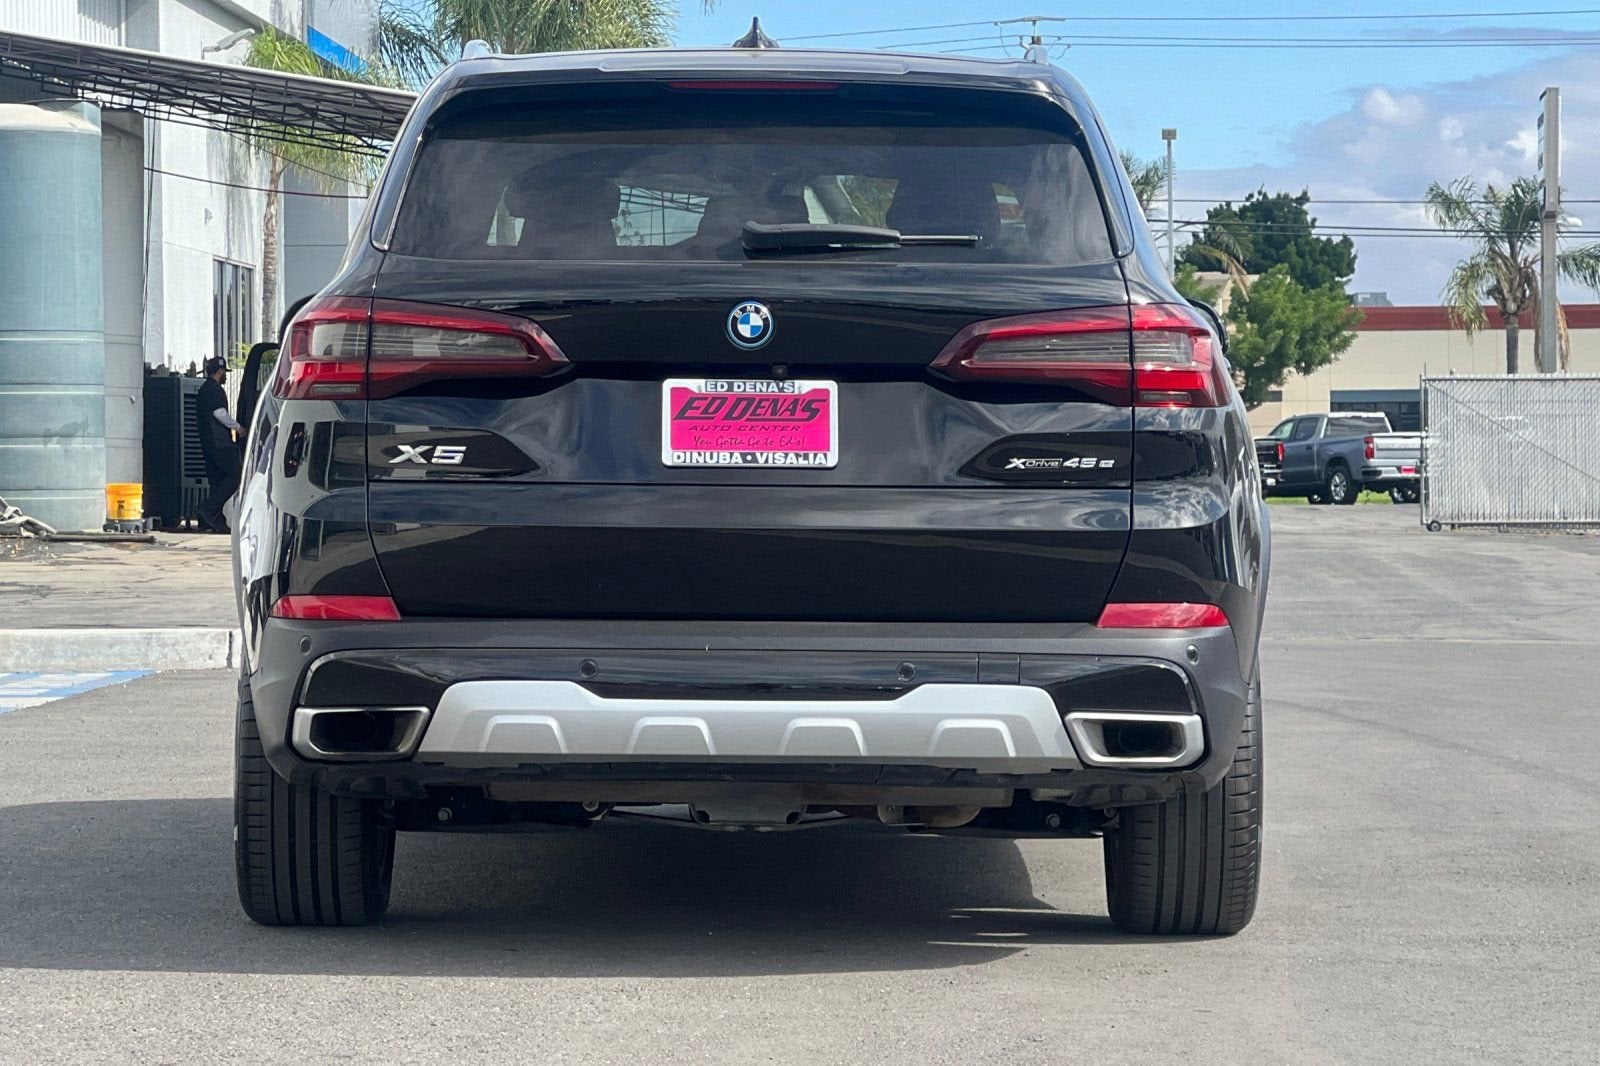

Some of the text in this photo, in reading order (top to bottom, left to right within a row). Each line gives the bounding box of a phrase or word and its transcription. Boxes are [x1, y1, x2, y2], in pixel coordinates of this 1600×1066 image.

[735, 305, 768, 319] BMW
[706, 381, 795, 393] ED DENA'S
[673, 397, 827, 422] ED DENA'S
[688, 424, 802, 432] AUTO CENTER
[694, 436, 805, 448] You Gotta Go to Ed's!
[388, 445, 467, 465] X5
[673, 452, 828, 465] DINUBA VISALIA
